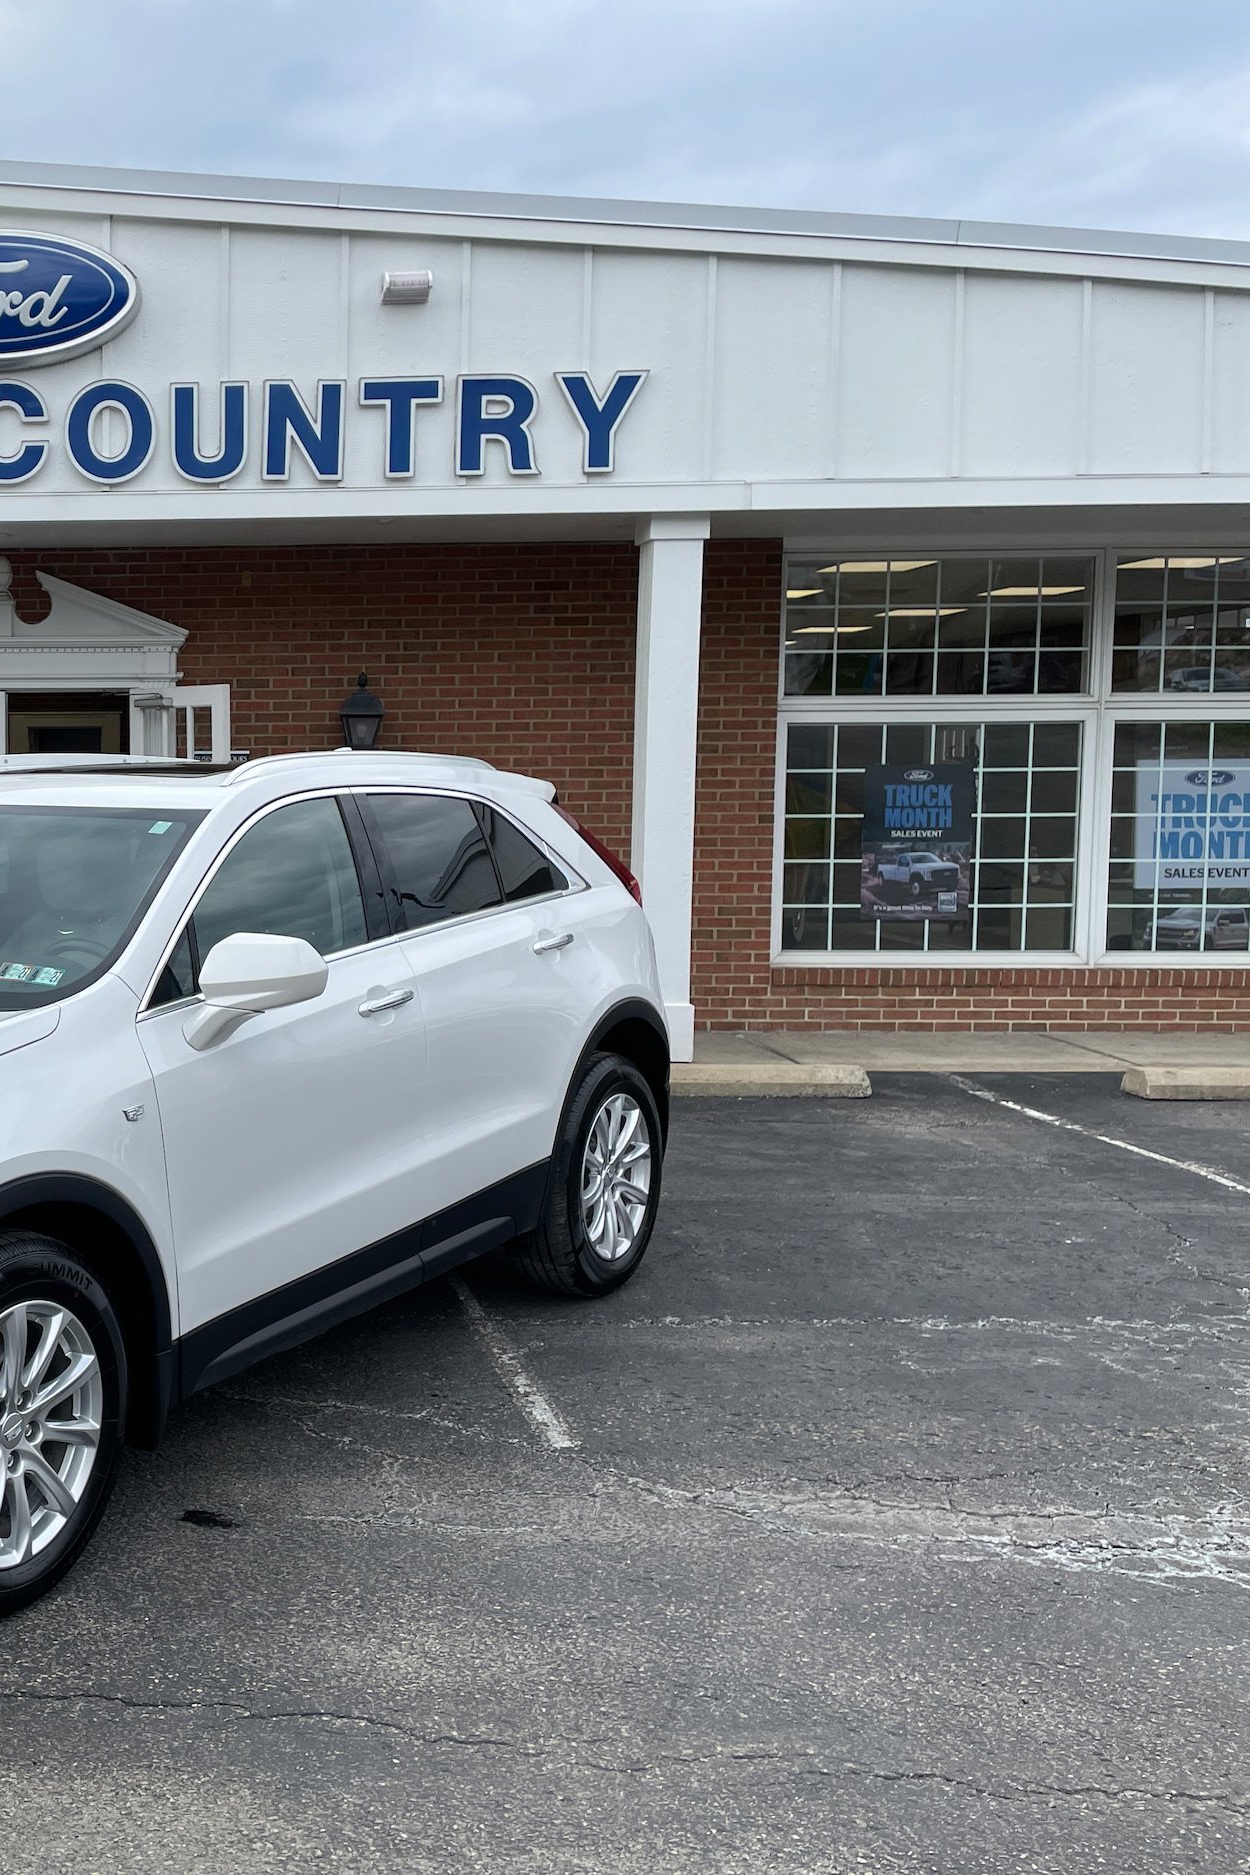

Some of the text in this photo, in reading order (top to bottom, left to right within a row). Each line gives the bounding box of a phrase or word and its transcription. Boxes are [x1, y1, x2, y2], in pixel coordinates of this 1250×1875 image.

[884, 784, 953, 807] TRUCK
[884, 807, 953, 828] MONTH
[891, 829, 943, 838] SALES EVENT
[1153, 831, 1250, 859] MONT
[1164, 867, 1250, 878] SALES EVENT
[29, 1262, 93, 1291] SUMMIT
